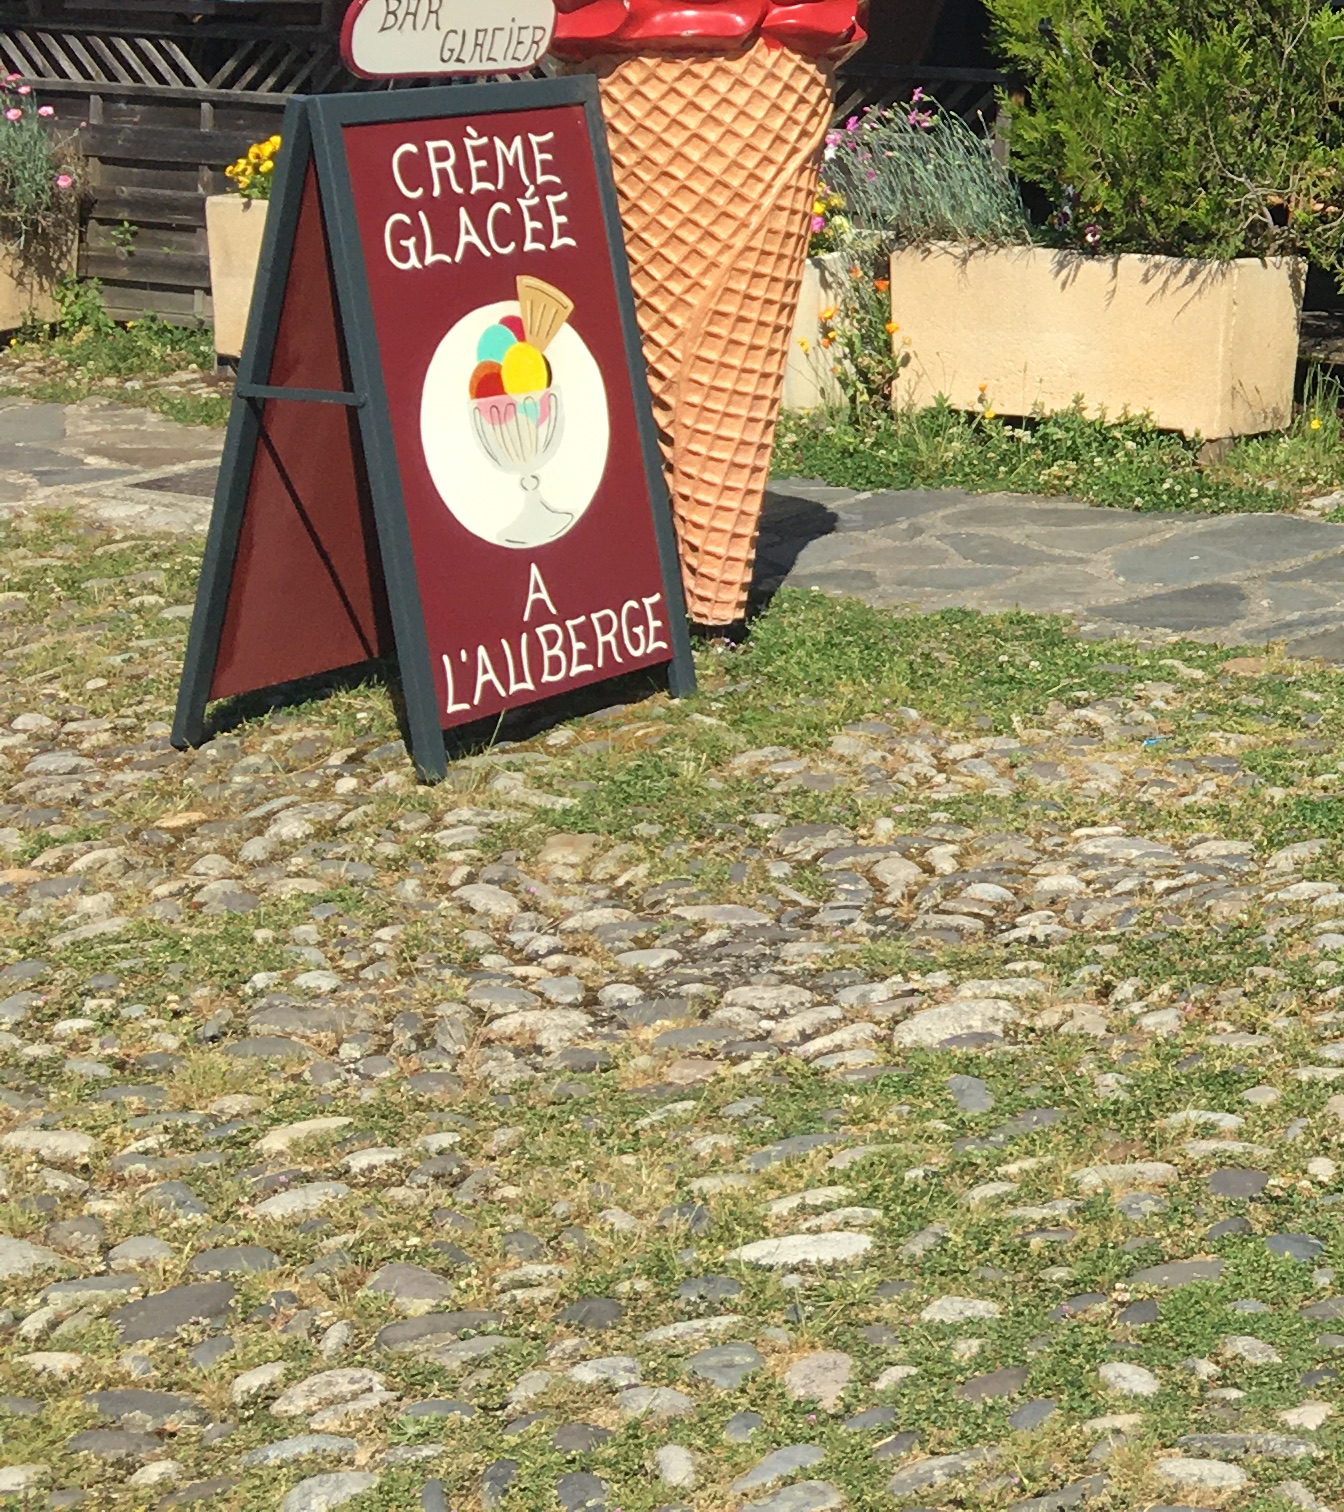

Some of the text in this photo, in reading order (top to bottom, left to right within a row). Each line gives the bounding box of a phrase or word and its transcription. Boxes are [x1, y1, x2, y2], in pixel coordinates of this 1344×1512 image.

[439, 17, 547, 64] GLACIER
[391, 125, 563, 199] CRÈME
[384, 184, 578, 270] GLACÉE
[522, 562, 558, 622] A
[441, 591, 669, 714] L'AUBERGE
